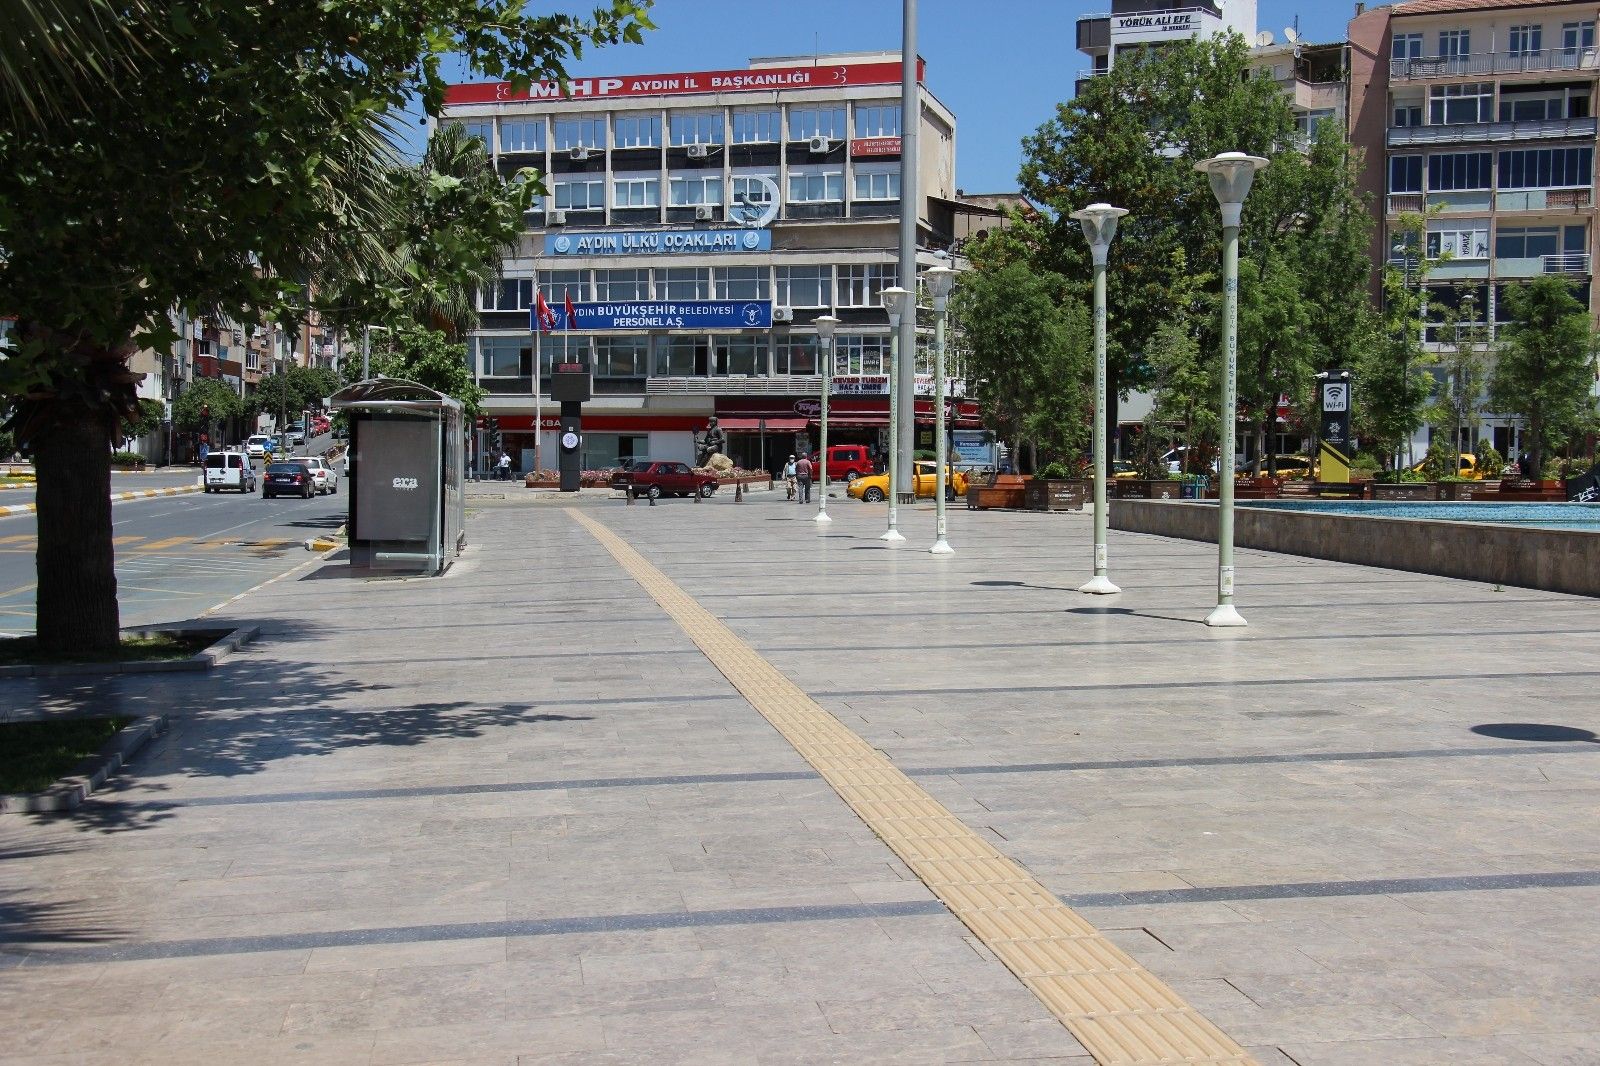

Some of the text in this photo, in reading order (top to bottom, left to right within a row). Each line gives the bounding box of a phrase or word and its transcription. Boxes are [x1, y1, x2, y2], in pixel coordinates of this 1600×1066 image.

[1119, 17, 1153, 28] YÖRÜK
[1173, 15, 1191, 24] EFE
[529, 71, 810, 98] MHP AYDIN İL BAŞKANLIĞI
[577, 233, 737, 249] AYDIN ÜLKÜ OCAKLARI
[567, 308, 595, 317] YDIN
[597, 304, 676, 318] BÜYÜKŞEHİR
[679, 305, 734, 315] BELEDİYESİ
[613, 317, 685, 329] PERSONEL A.Ş.
